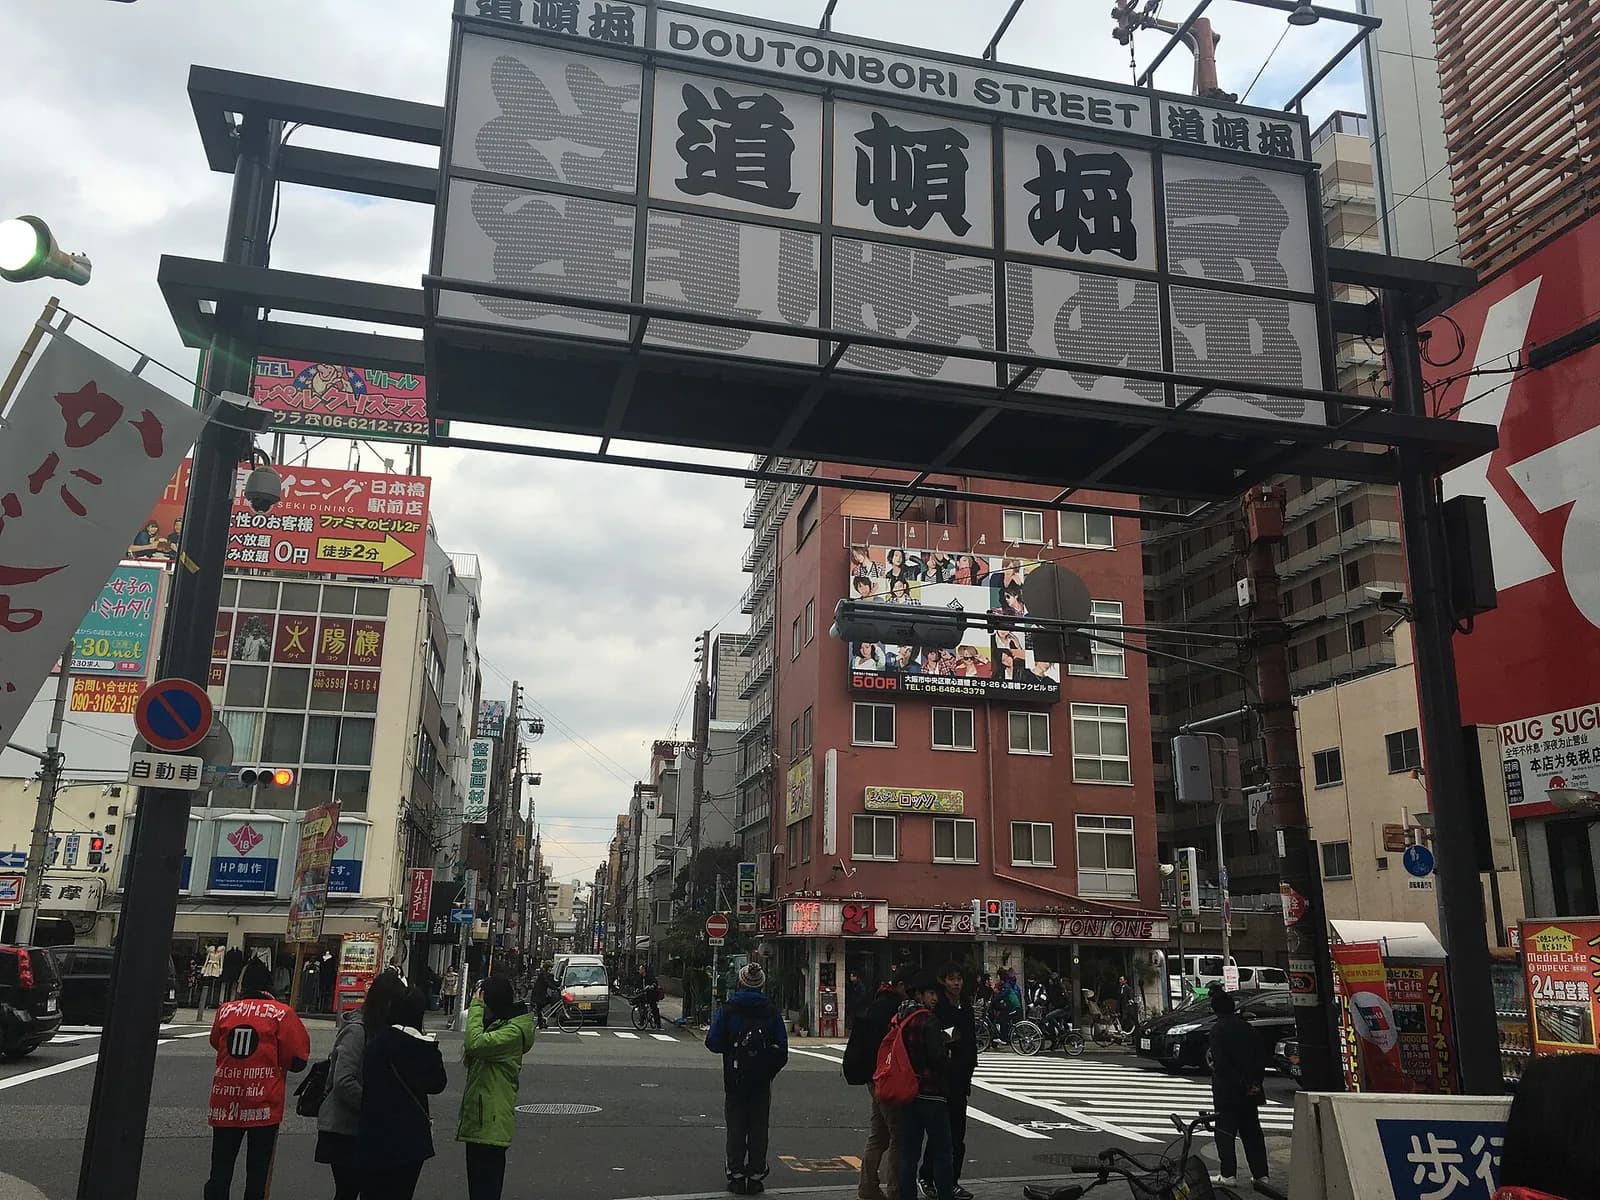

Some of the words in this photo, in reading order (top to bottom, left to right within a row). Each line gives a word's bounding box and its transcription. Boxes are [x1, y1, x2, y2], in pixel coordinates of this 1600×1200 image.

[668, 22, 958, 98] DOUTONBORI
[972, 77, 1141, 129] STREET
[1168, 105, 1297, 159] 道頓堀
[674, 82, 1139, 262] 道頓堀
[364, 368, 420, 391] リトル
[370, 479, 425, 497] 日本橋
[309, 504, 355, 514] DINING
[367, 498, 424, 516] 駅前店
[274, 541, 310, 564] 0円
[322, 544, 380, 561] 徒歩2分
[853, 676, 897, 690] 500円
[131, 759, 198, 782] 自動車
[412, 870, 425, 920] ホームメイト
[841, 903, 878, 933] 21
[895, 913, 950, 930] CAFE
[1527, 952, 1559, 963] Media
[1560, 953, 1588, 963] Cafe
